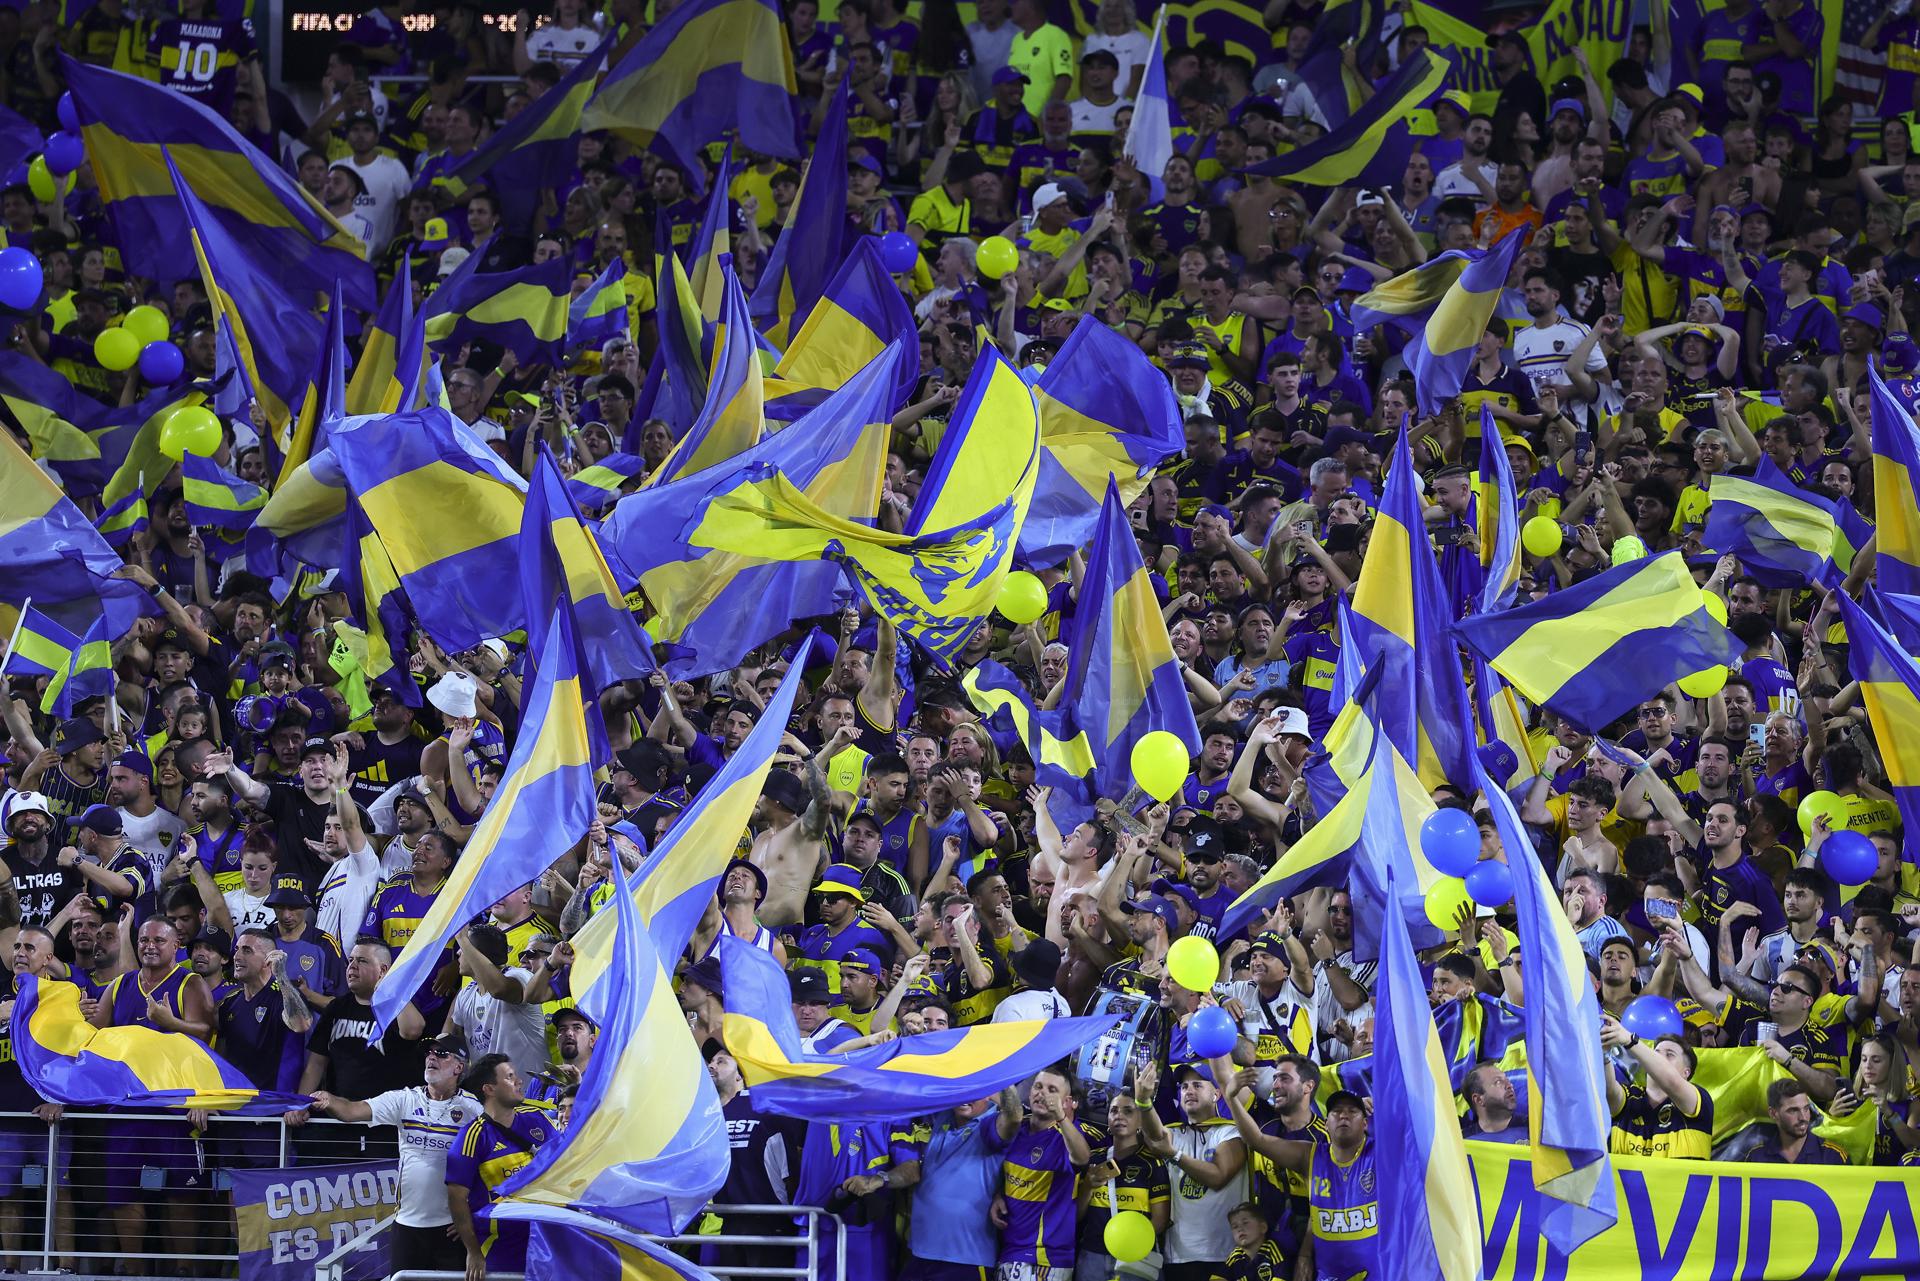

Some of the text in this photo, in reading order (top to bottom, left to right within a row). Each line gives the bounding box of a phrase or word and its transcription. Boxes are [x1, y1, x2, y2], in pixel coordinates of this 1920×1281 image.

[292, 13, 331, 31] FIFA
[180, 23, 222, 40] MARADONA
[173, 41, 218, 82] 10
[1522, 366, 1563, 379] etsson
[1227, 381, 1254, 406] JUNI
[1670, 400, 1712, 413] betsson
[277, 878, 303, 892] BOCA
[391, 927, 416, 938] bets
[1104, 1029, 1128, 1042] ADONA
[725, 1120, 760, 1133] EST
[266, 1169, 399, 1220] COMOD
[1181, 1186, 1205, 1197] BOCA
[1318, 1209, 1378, 1235] CABJ
[1618, 1168, 1920, 1281] VIDA
[269, 1226, 319, 1265] ES
